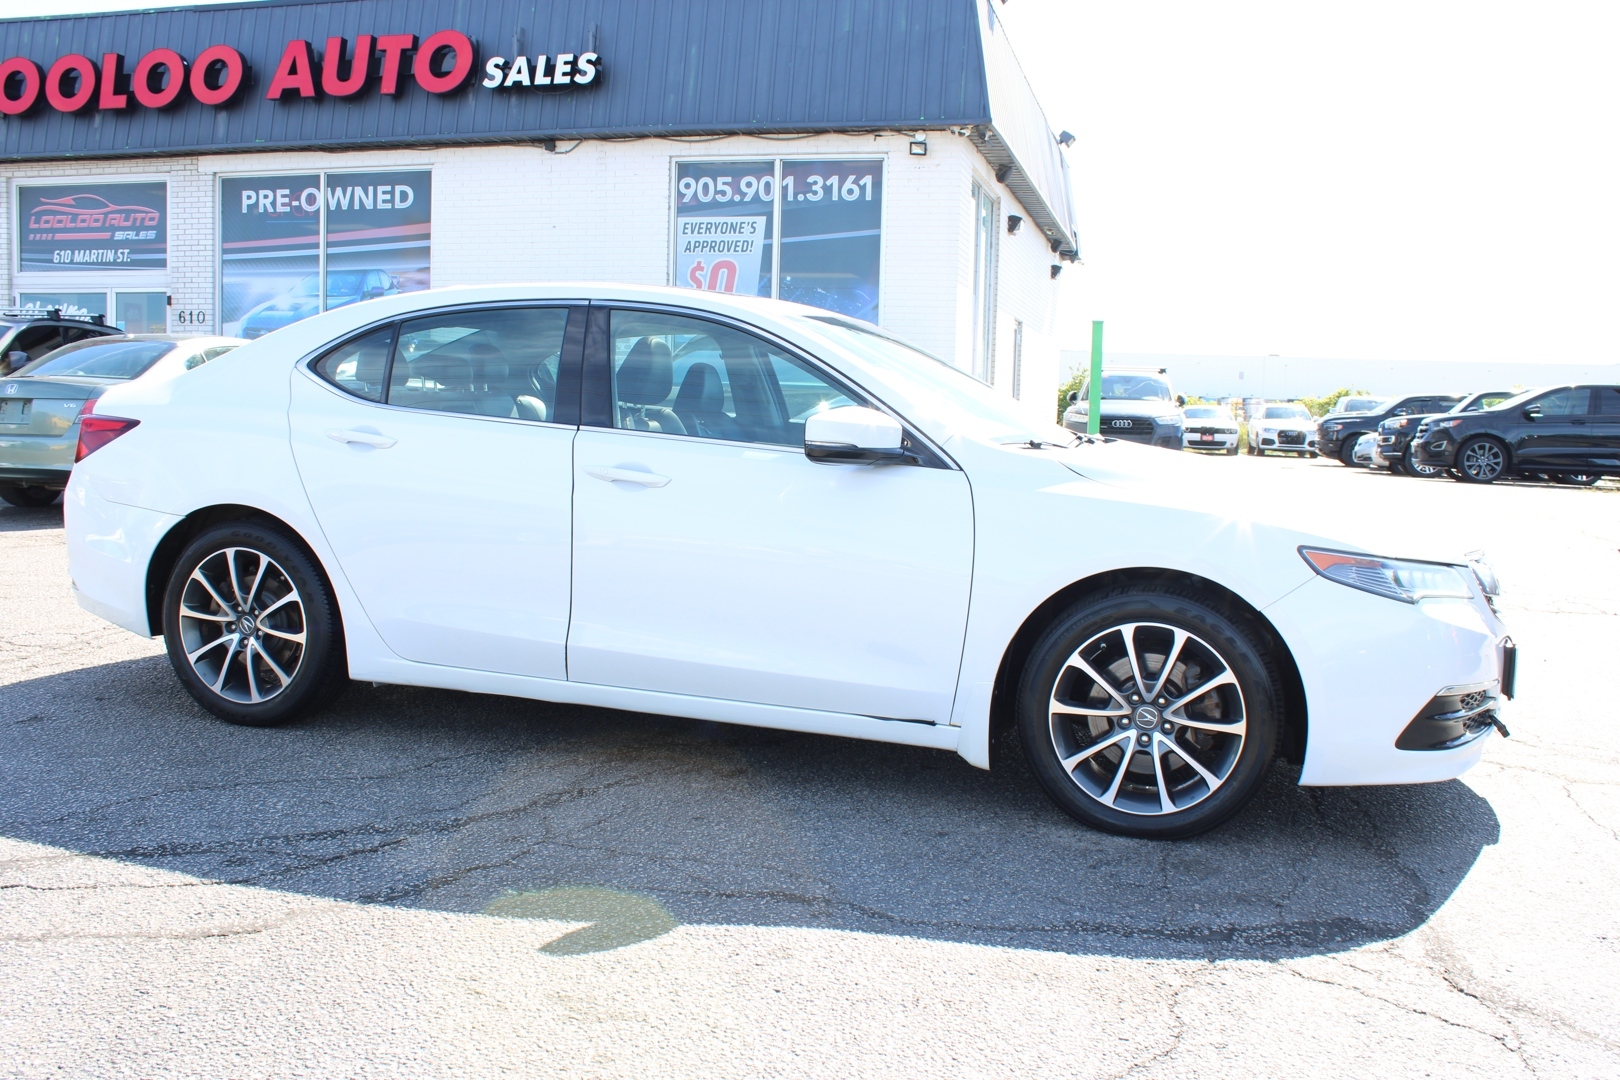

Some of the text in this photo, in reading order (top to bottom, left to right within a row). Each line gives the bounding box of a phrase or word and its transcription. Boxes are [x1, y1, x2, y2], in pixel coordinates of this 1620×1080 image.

[265, 29, 474, 100] AUTO
[482, 51, 599, 89] SALES
[679, 175, 872, 203] 905.901.3161
[241, 185, 414, 214] PRE-OWNED
[29, 212, 160, 229] LOOLOO AUTO
[113, 230, 157, 240] SALES
[682, 221, 757, 236] EVERYONE'S
[684, 240, 754, 254] APPROVED!
[53, 249, 131, 263] 610 MARTIN ST.
[178, 310, 206, 325] 610
